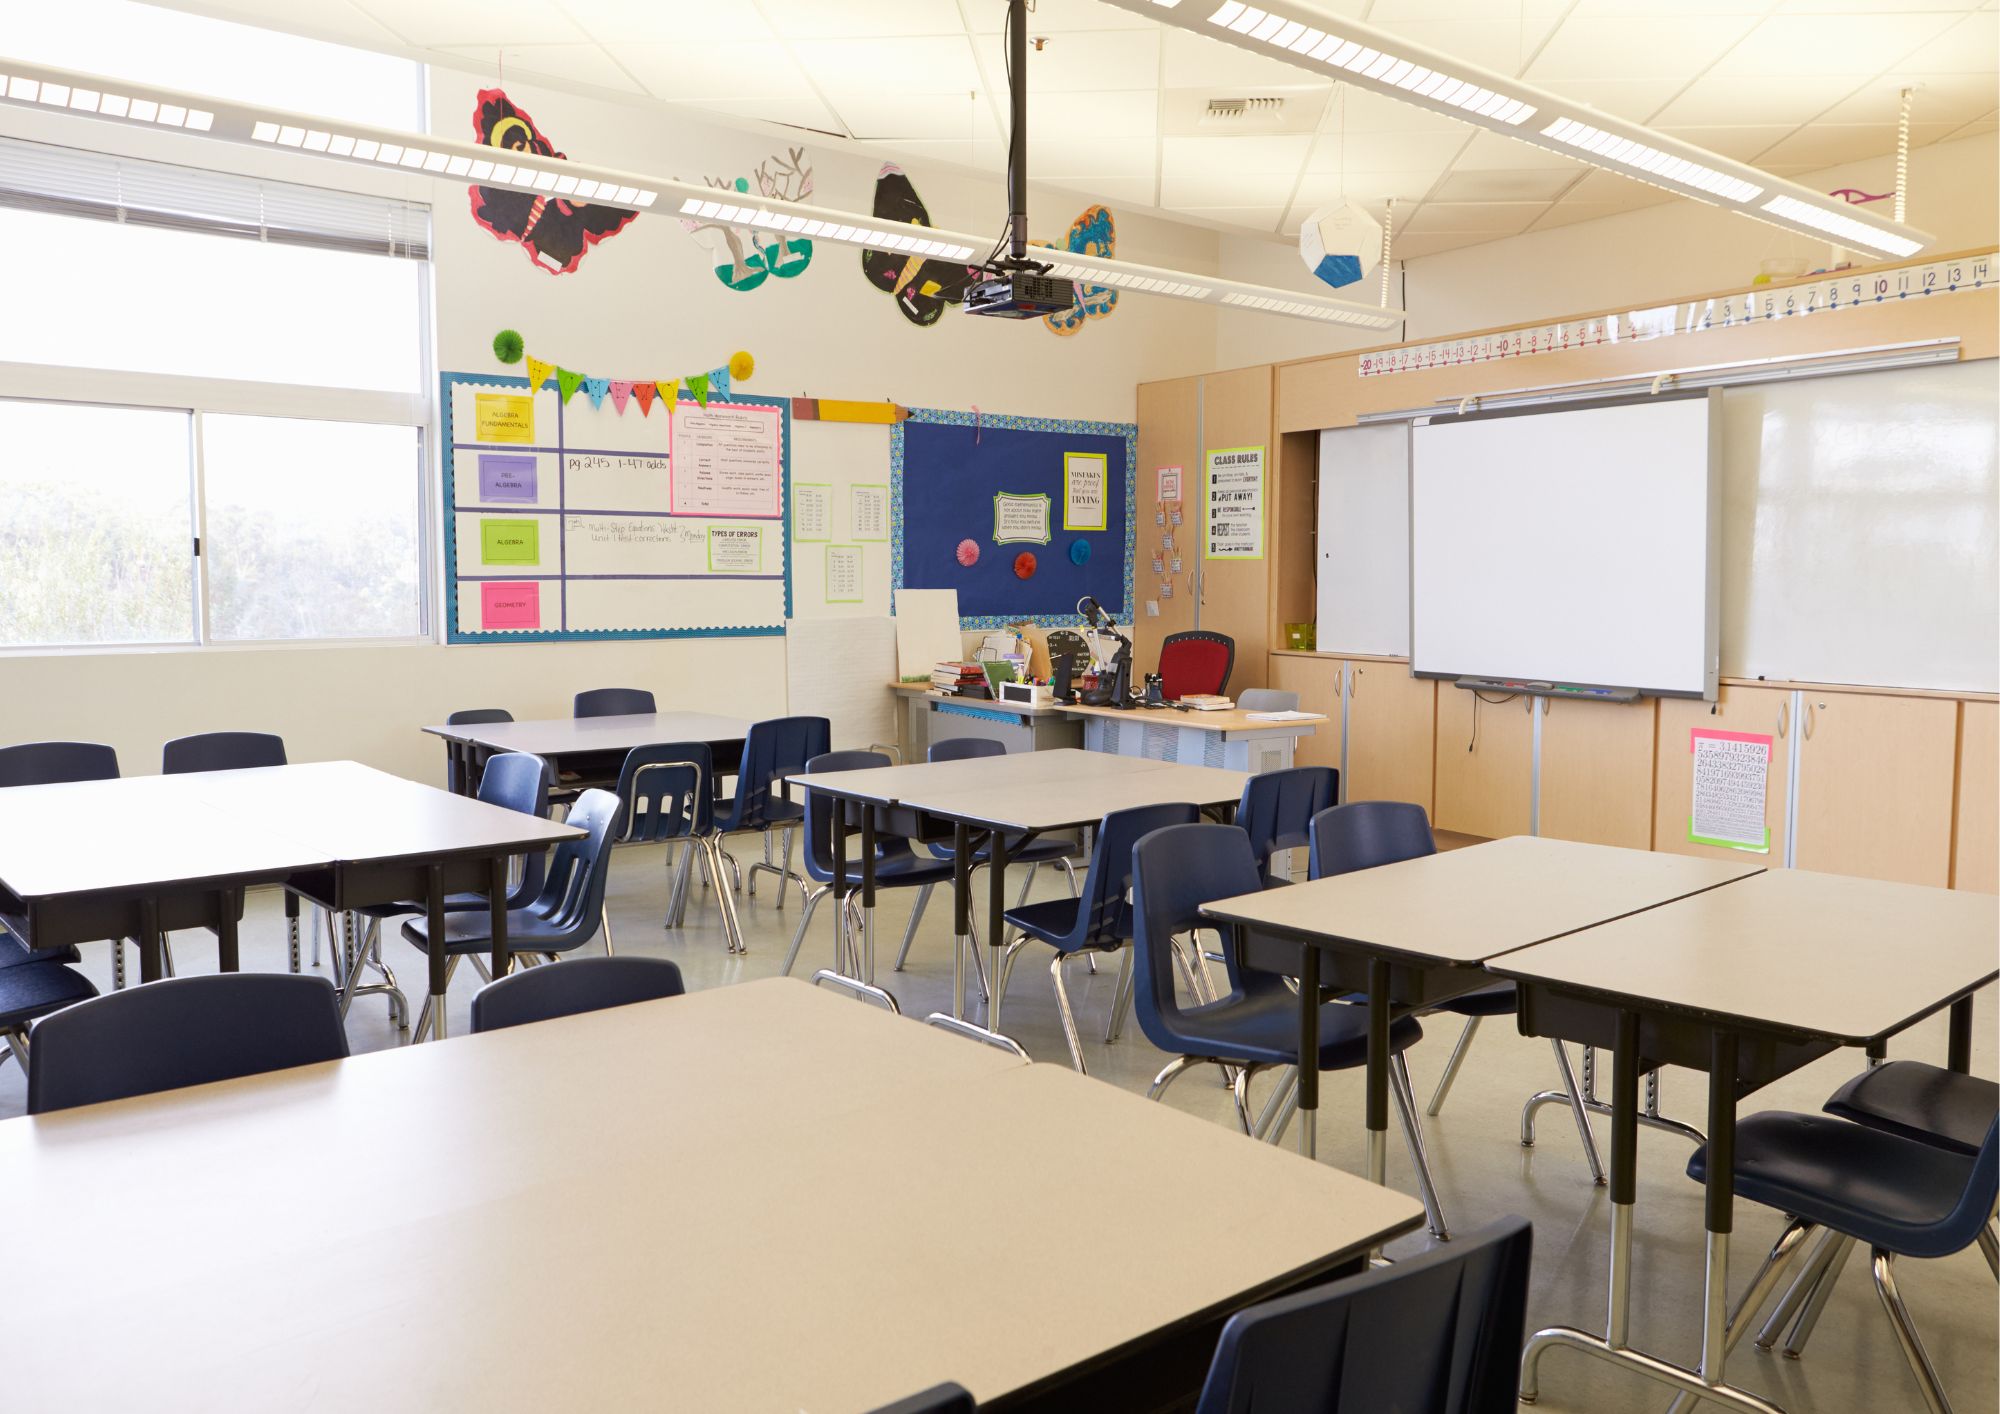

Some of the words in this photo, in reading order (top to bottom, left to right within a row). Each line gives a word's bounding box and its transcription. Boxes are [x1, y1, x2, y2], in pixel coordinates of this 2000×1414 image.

[1360, 359, 1372, 370] -20
[1374, 358, 1384, 368] -19
[1386, 356, 1396, 366] -18
[1399, 354, 1409, 365] -17
[1412, 352, 1422, 363] -16
[1426, 350, 1436, 361] -15
[1440, 348, 1450, 359] -14
[1453, 346, 1464, 358] -13
[1467, 344, 1478, 356] -12
[1482, 343, 1492, 354] -11
[1496, 339, 1508, 352] -10
[1512, 338, 1522, 348] -9
[1528, 335, 1537, 347] -8
[1544, 333, 1552, 344] -7
[1560, 330, 1569, 342] -6
[1576, 328, 1586, 340] -5
[1592, 325, 1602, 336] -4
[1704, 308, 1712, 320] 2
[1724, 304, 1731, 317] 3
[1766, 298, 1774, 311] 5
[1786, 295, 1794, 308] 6
[1808, 291, 1816, 304] 7
[1830, 288, 1838, 300] 8
[1852, 284, 1860, 296] 9
[1874, 280, 1888, 294] 10
[1898, 276, 1909, 291] 11
[1922, 272, 1936, 287] 12
[1948, 268, 1961, 283] 13
[1974, 264, 1988, 279] 14
[482, 420, 528, 428] FUNDAMENTALS
[569, 458, 580, 471] pg
[584, 456, 610, 469] 245
[618, 458, 642, 469] 1-47
[646, 459, 667, 469] odds
[1214, 455, 1236, 465] CLASS
[1237, 453, 1258, 464] RULES
[1072, 496, 1100, 504] TRYING
